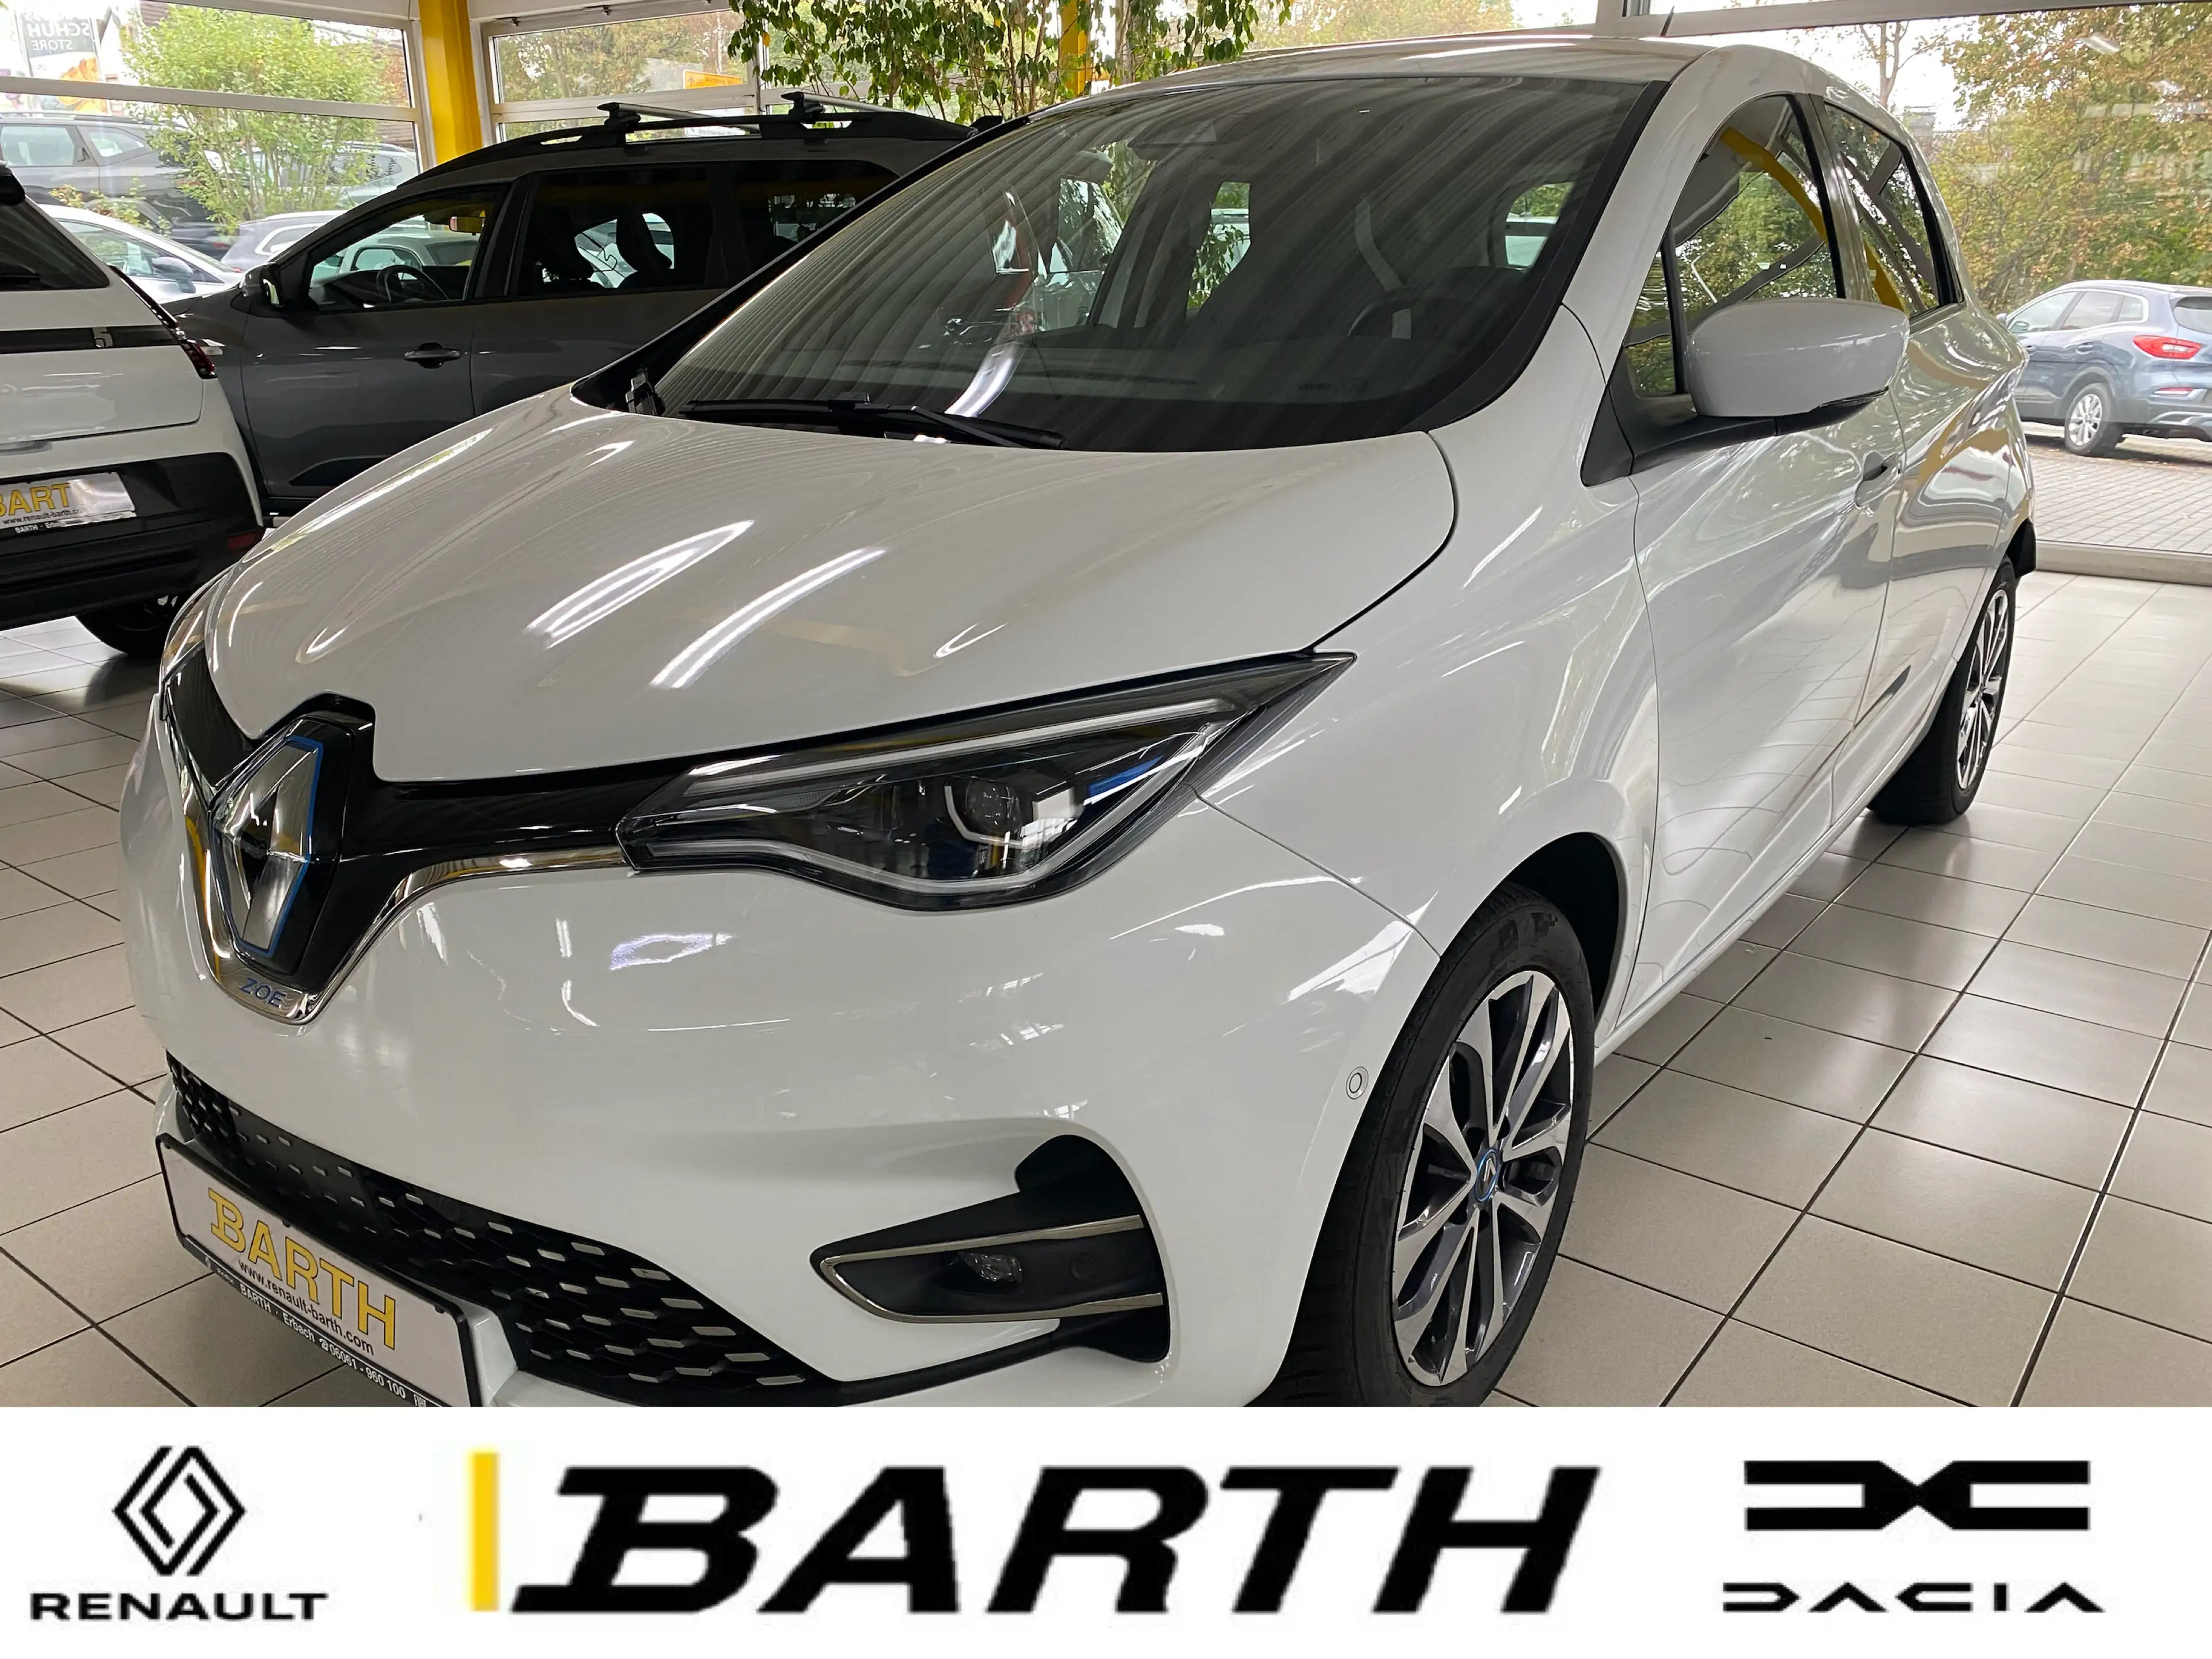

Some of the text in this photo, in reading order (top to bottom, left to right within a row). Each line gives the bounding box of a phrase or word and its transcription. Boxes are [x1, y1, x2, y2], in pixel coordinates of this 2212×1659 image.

[14, 524, 39, 533] BARTH
[240, 978, 287, 1008] ZOE
[208, 1187, 396, 1350] BARTH
[238, 1259, 374, 1356] www.renault-barth.com
[239, 1283, 272, 1313] BARTH
[282, 1312, 315, 1343] Erbach
[329, 1343, 357, 1370] 06061
[365, 1367, 385, 1387] 960
[387, 1379, 406, 1399] 100
